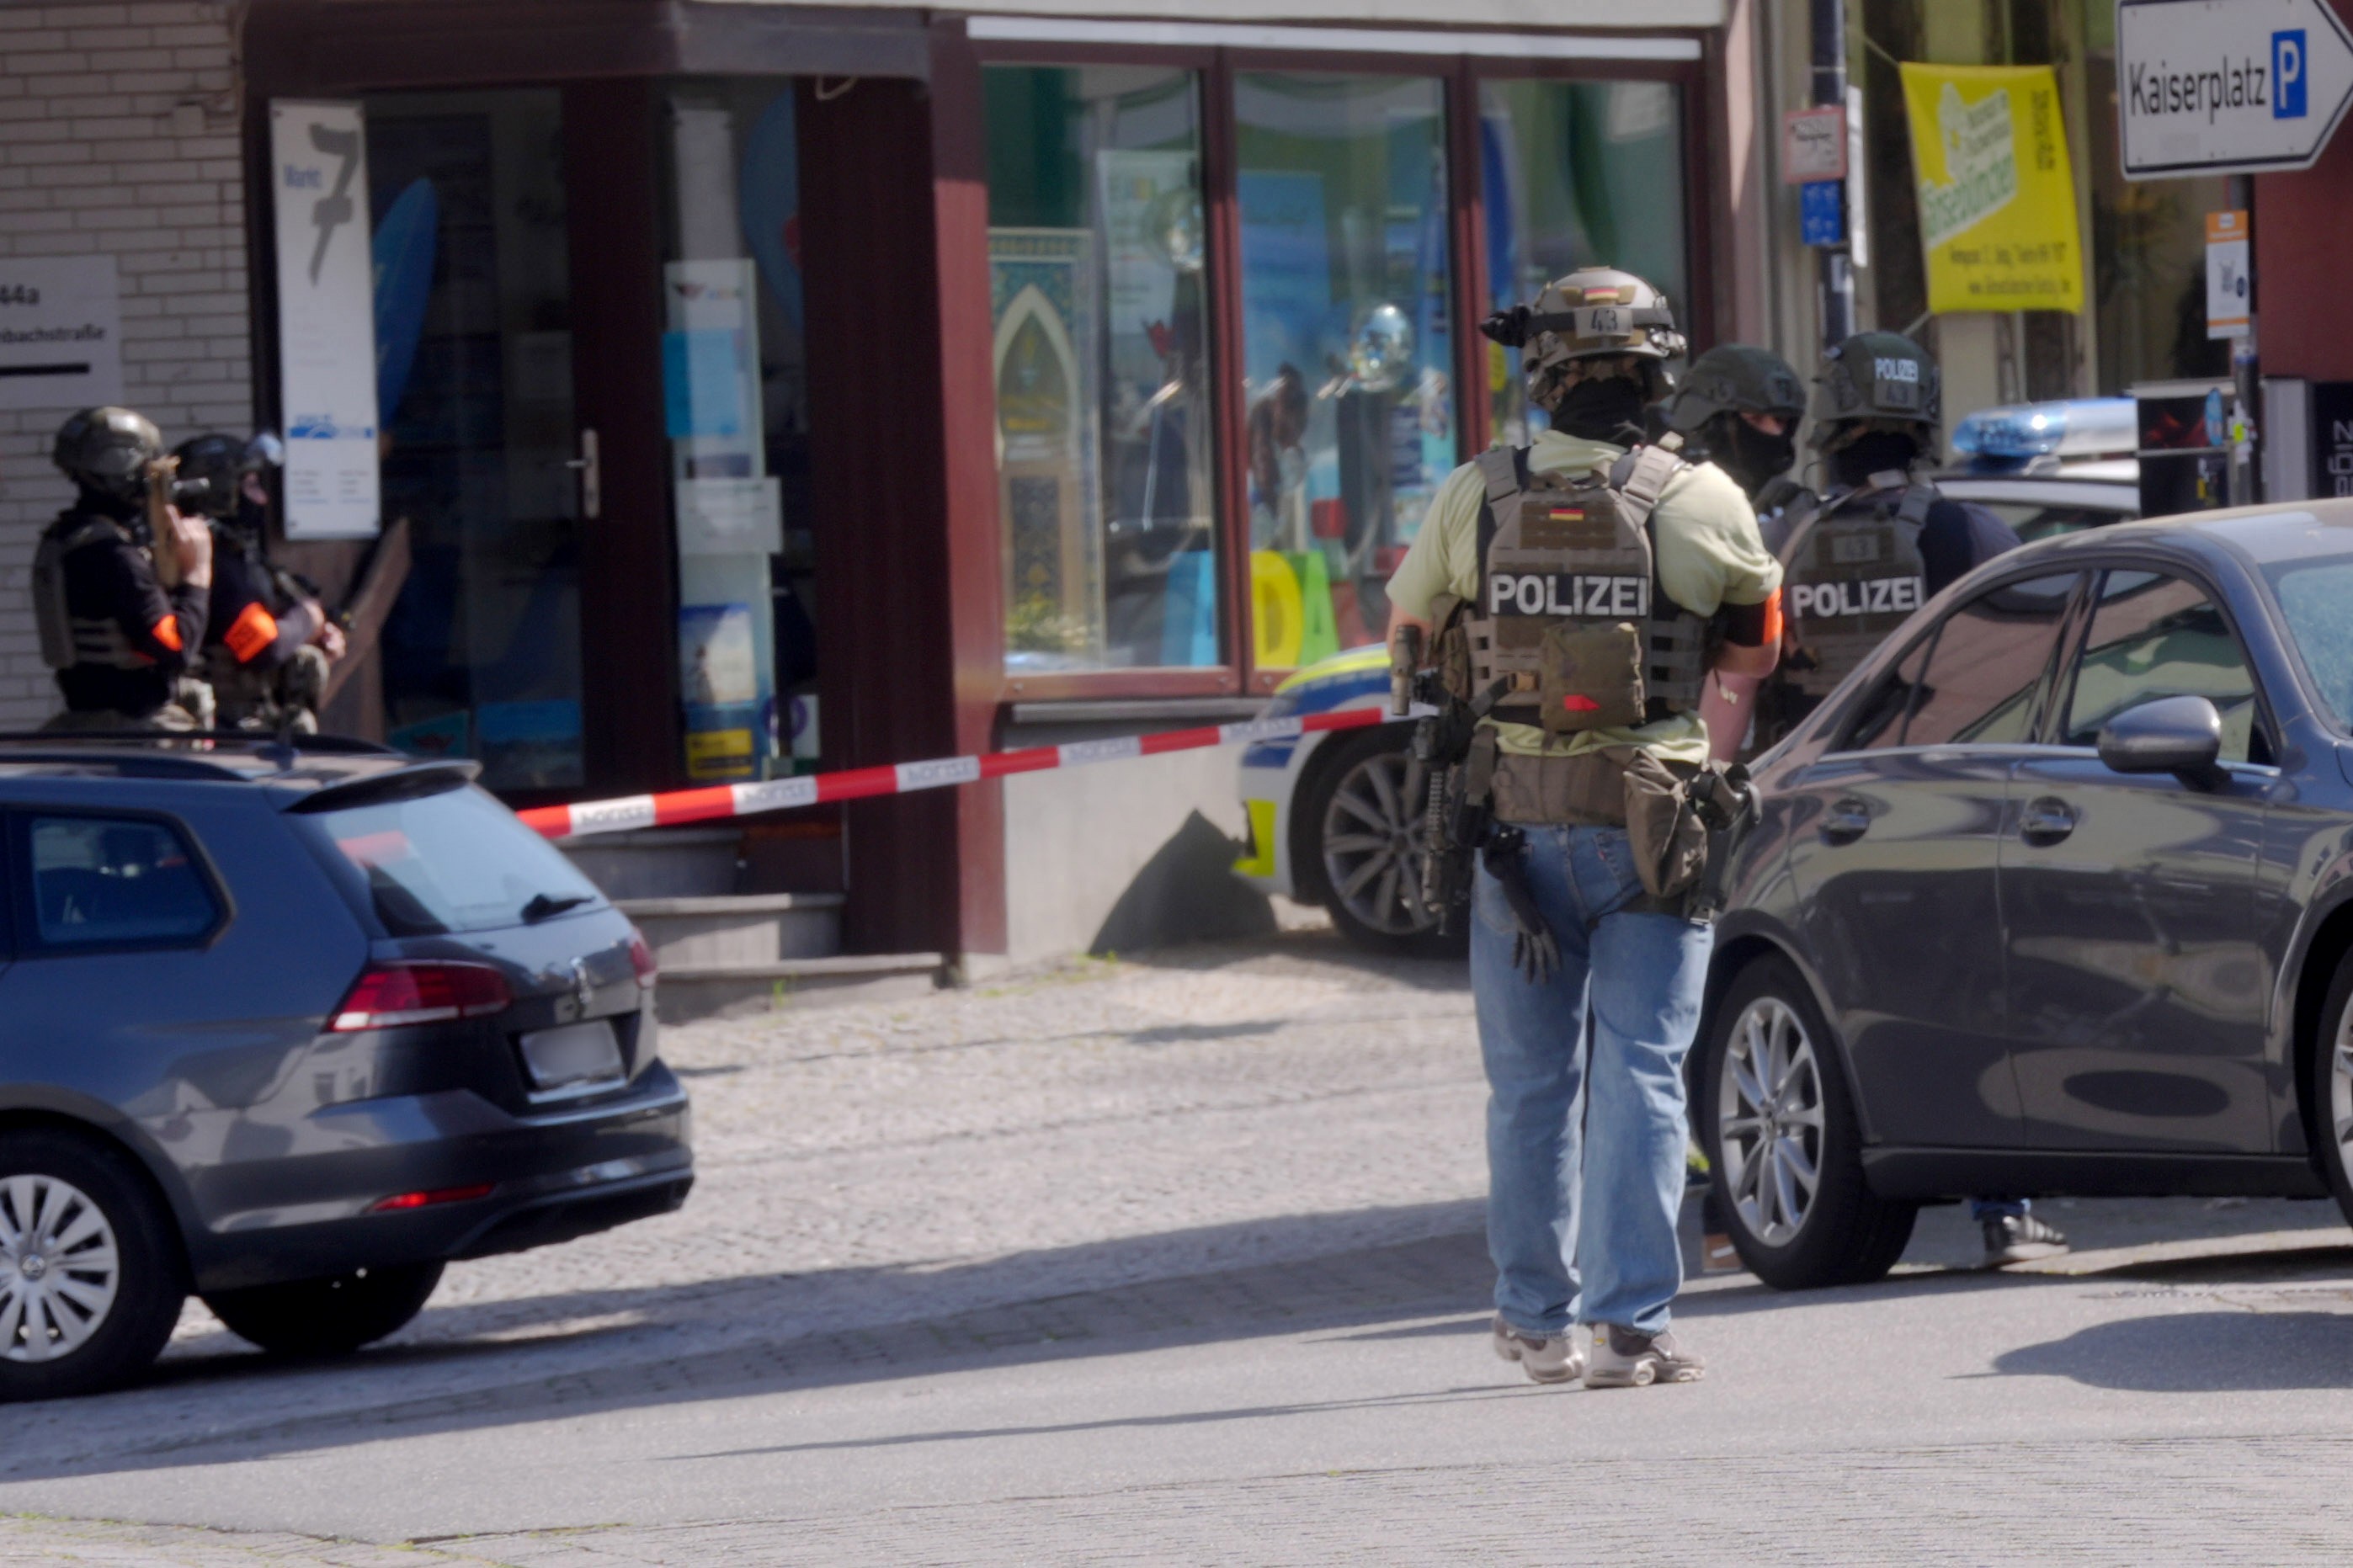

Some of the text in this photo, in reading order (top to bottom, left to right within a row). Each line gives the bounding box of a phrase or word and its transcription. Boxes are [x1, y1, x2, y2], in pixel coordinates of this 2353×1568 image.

[2128, 55, 2267, 125] Kaiserplatz
[1490, 575, 1648, 615] POLIZEI
[1791, 576, 1924, 619] POLIZEI
